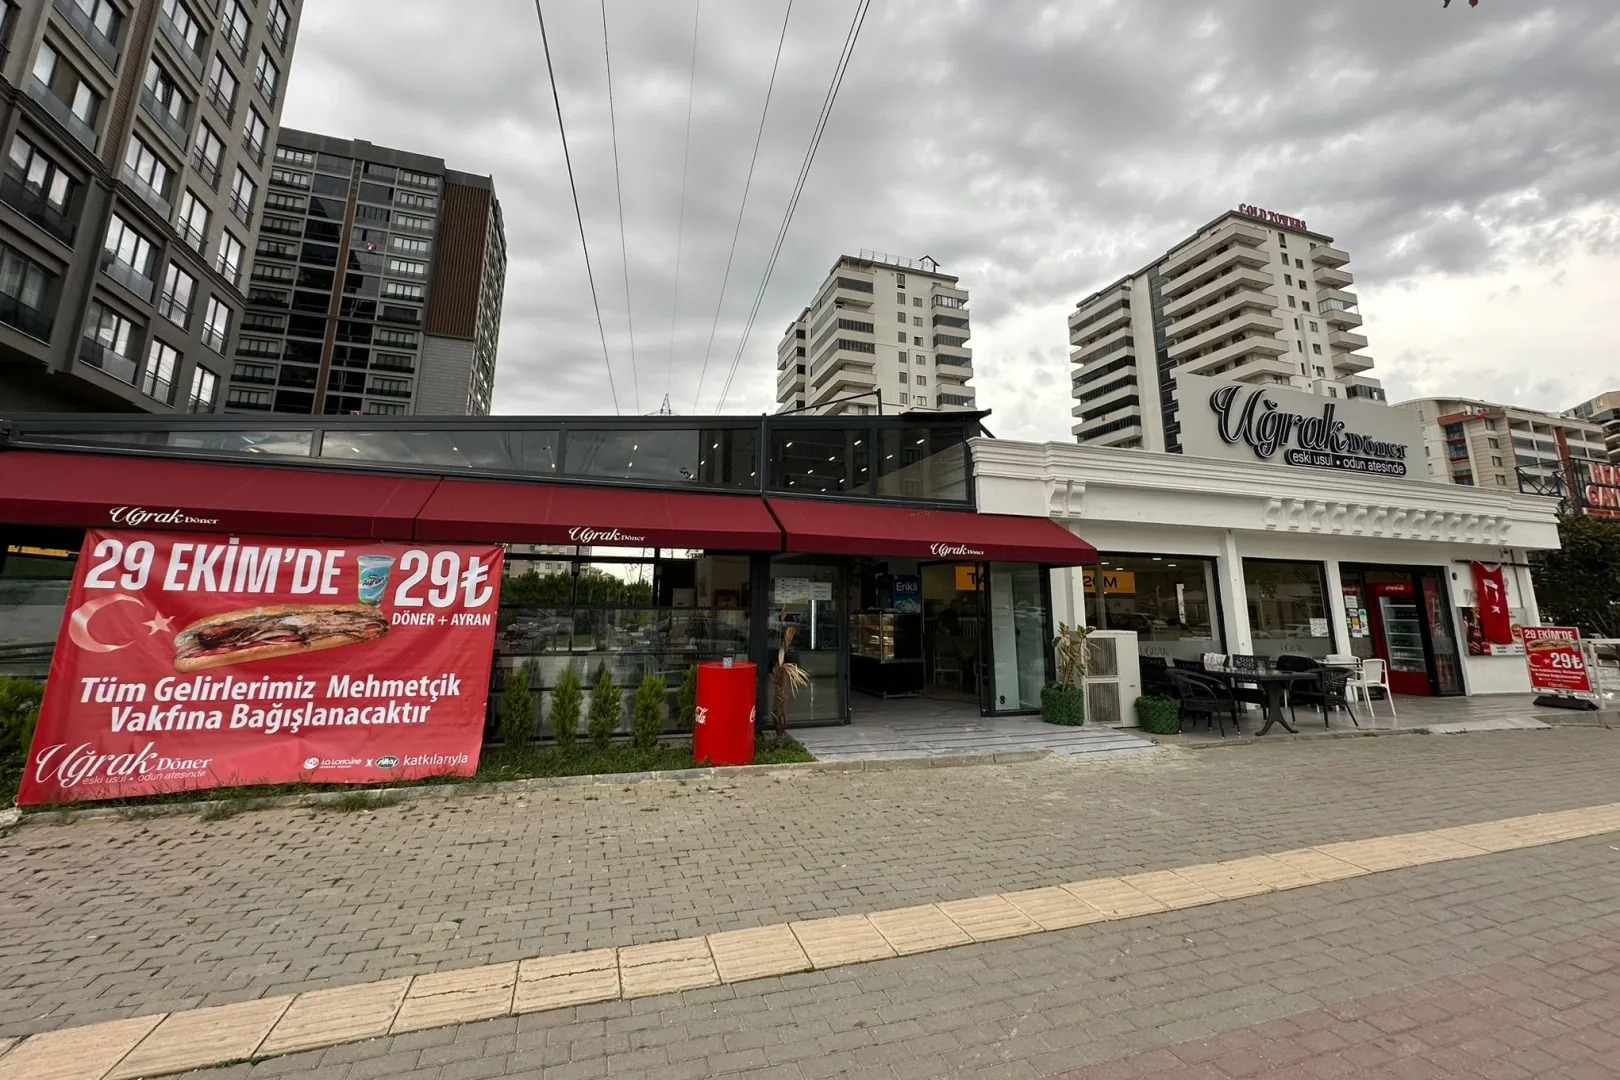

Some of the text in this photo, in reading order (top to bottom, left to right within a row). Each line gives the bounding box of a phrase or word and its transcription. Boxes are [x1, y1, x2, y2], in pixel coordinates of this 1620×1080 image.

[1209, 385, 1408, 459] Uğrak Döner
[1292, 451, 1312, 464] eski
[1314, 454, 1334, 467] usul
[1343, 457, 1367, 471] odun
[109, 506, 219, 526] Uğrak Döner
[84, 537, 345, 594] 29 EKİM'DE
[896, 582, 918, 591] Erikli
[391, 610, 436, 626] DÖNER
[450, 613, 491, 627] AYRAN
[1524, 629, 1537, 639] 29
[80, 672, 462, 703] Tüm Gelirlerimiz Mehmetçik
[111, 700, 431, 733] Vakfına Bağışlanacaktır
[35, 741, 213, 789] Uğrak Döner
[331, 757, 362, 765] Lorraine
[403, 752, 468, 766] katkılarıyla
[82, 774, 104, 786] eski
[137, 770, 163, 782] odun
